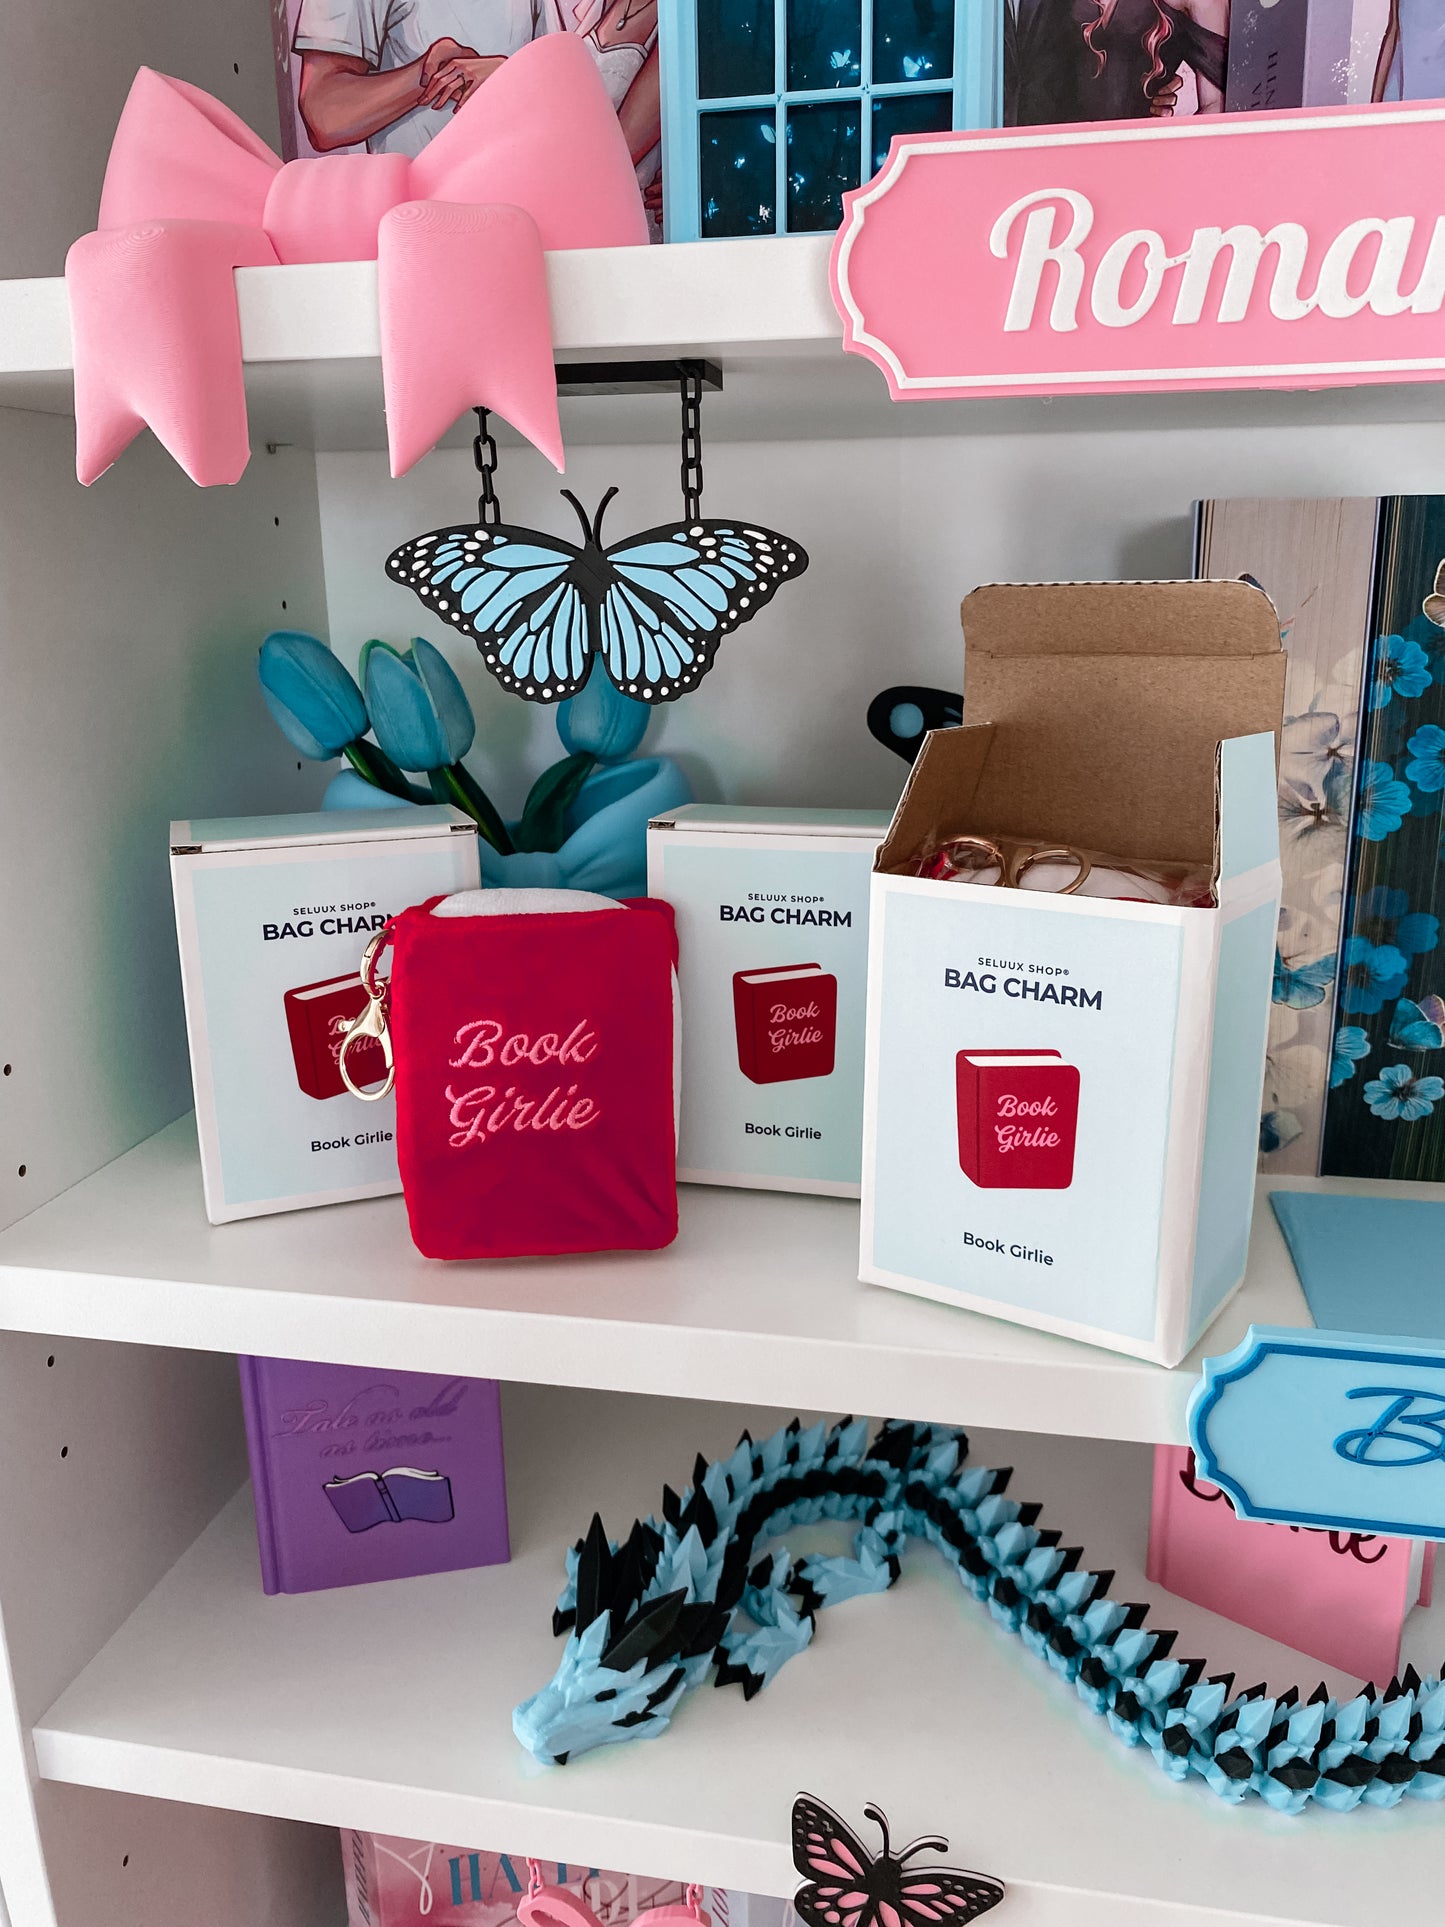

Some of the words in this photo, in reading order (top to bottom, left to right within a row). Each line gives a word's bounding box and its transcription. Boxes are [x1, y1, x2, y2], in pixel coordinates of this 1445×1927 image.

[748, 893, 787, 902] SELUUX
[293, 905, 337, 916] SELUUX
[720, 905, 765, 923] BAG
[770, 908, 852, 928] CHARM
[262, 921, 314, 941] BAG
[320, 913, 394, 935] CHAR
[977, 957, 1024, 971] SELUUX
[944, 968, 997, 994] BAG
[1003, 977, 1102, 1011] CHARM
[769, 1001, 820, 1024] Book
[449, 1018, 598, 1068] Book
[768, 1026, 823, 1053] Girlie
[444, 1084, 601, 1147] Girlie
[997, 1094, 1058, 1118] Book
[311, 1136, 350, 1152] Book
[354, 1130, 393, 1146] Girlie
[745, 1122, 781, 1137] Book
[785, 1126, 822, 1140] Girlie
[994, 1125, 1061, 1153] Girlie
[963, 1231, 1005, 1255] Book
[1010, 1244, 1054, 1266] Girlie
